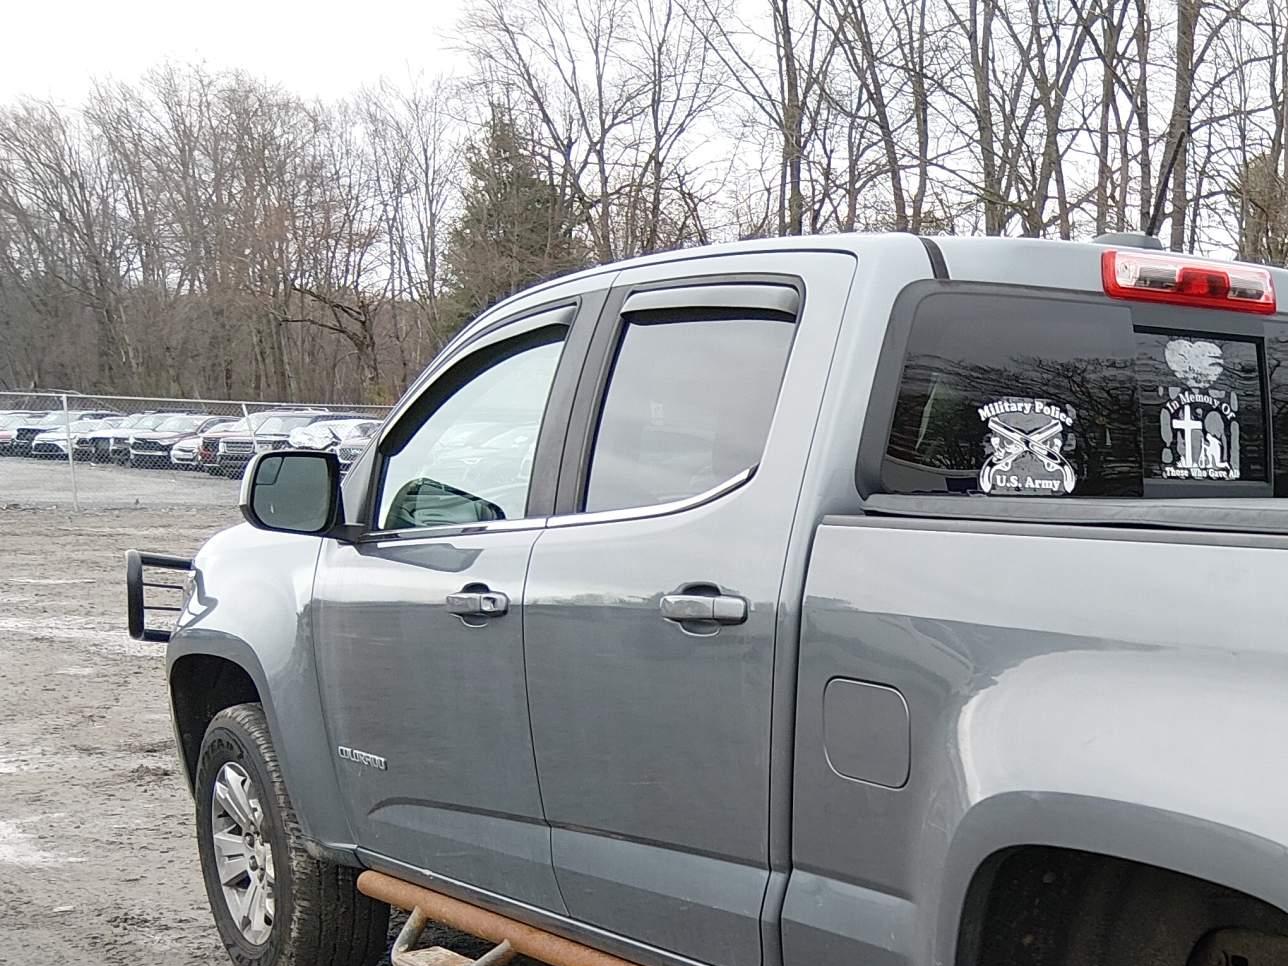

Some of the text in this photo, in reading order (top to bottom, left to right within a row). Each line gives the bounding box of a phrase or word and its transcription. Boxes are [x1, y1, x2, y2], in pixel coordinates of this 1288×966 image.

[1166, 400, 1180, 414] In
[1178, 390, 1220, 409] Memory
[978, 400, 1073, 427] Military Police
[1164, 466, 1189, 477] Those
[1190, 468, 1208, 478] Who
[1208, 469, 1228, 478] Gave
[996, 474, 1061, 491] U.S. Army
